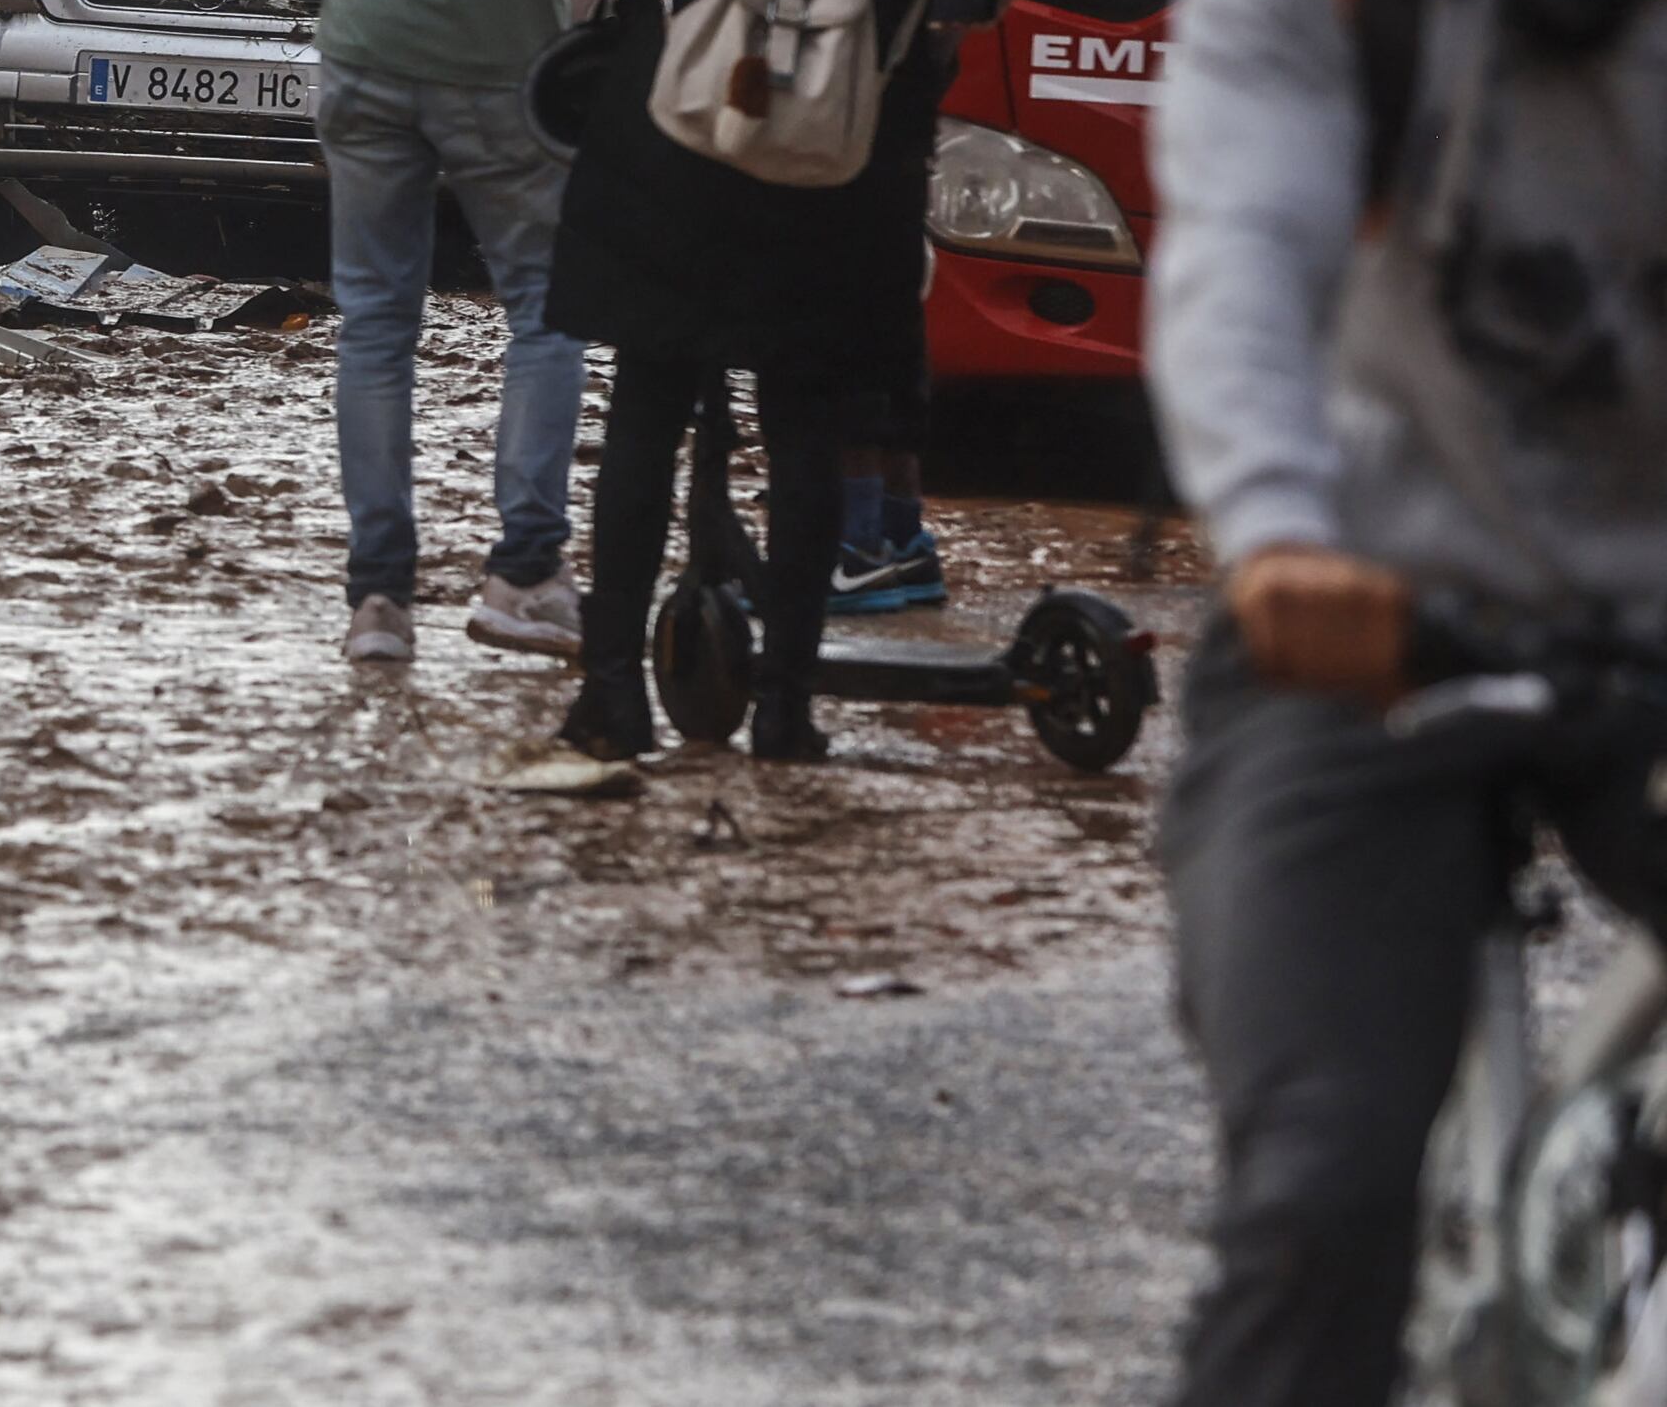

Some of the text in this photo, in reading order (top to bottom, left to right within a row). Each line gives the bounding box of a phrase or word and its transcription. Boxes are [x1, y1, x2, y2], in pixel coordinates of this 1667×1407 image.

[112, 64, 131, 98] V
[148, 67, 240, 105] 8482
[257, 72, 302, 108] HC
